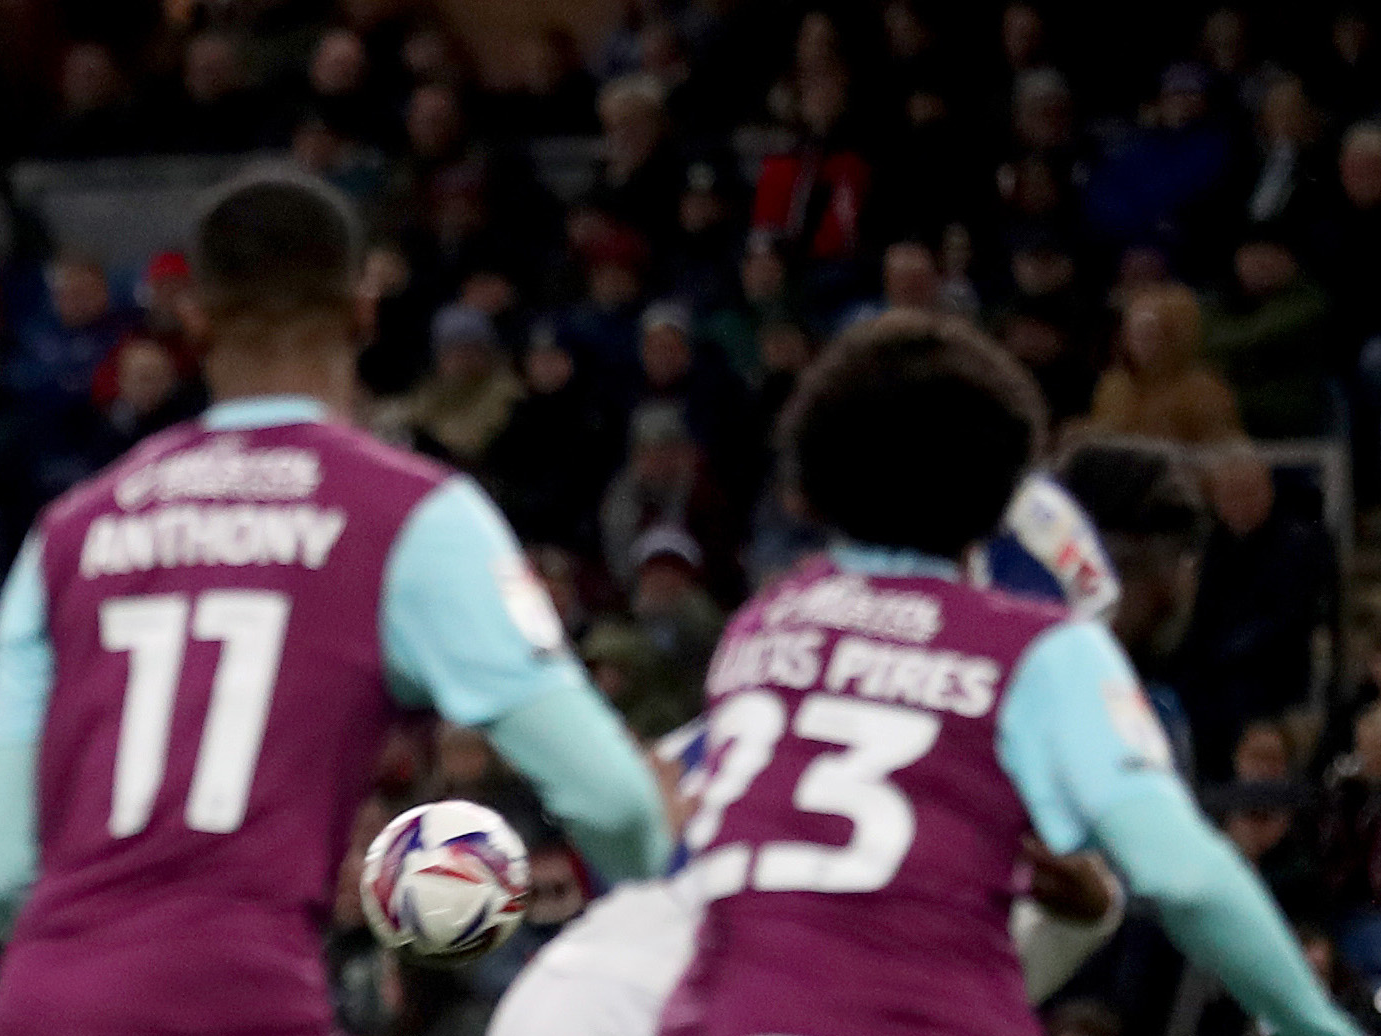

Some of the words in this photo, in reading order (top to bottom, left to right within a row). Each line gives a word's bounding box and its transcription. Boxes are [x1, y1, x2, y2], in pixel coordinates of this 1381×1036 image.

[78, 504, 347, 580] ANTHONY
[98, 587, 294, 840] 11
[824, 636, 1002, 718] PIRES
[678, 692, 942, 900] 23
